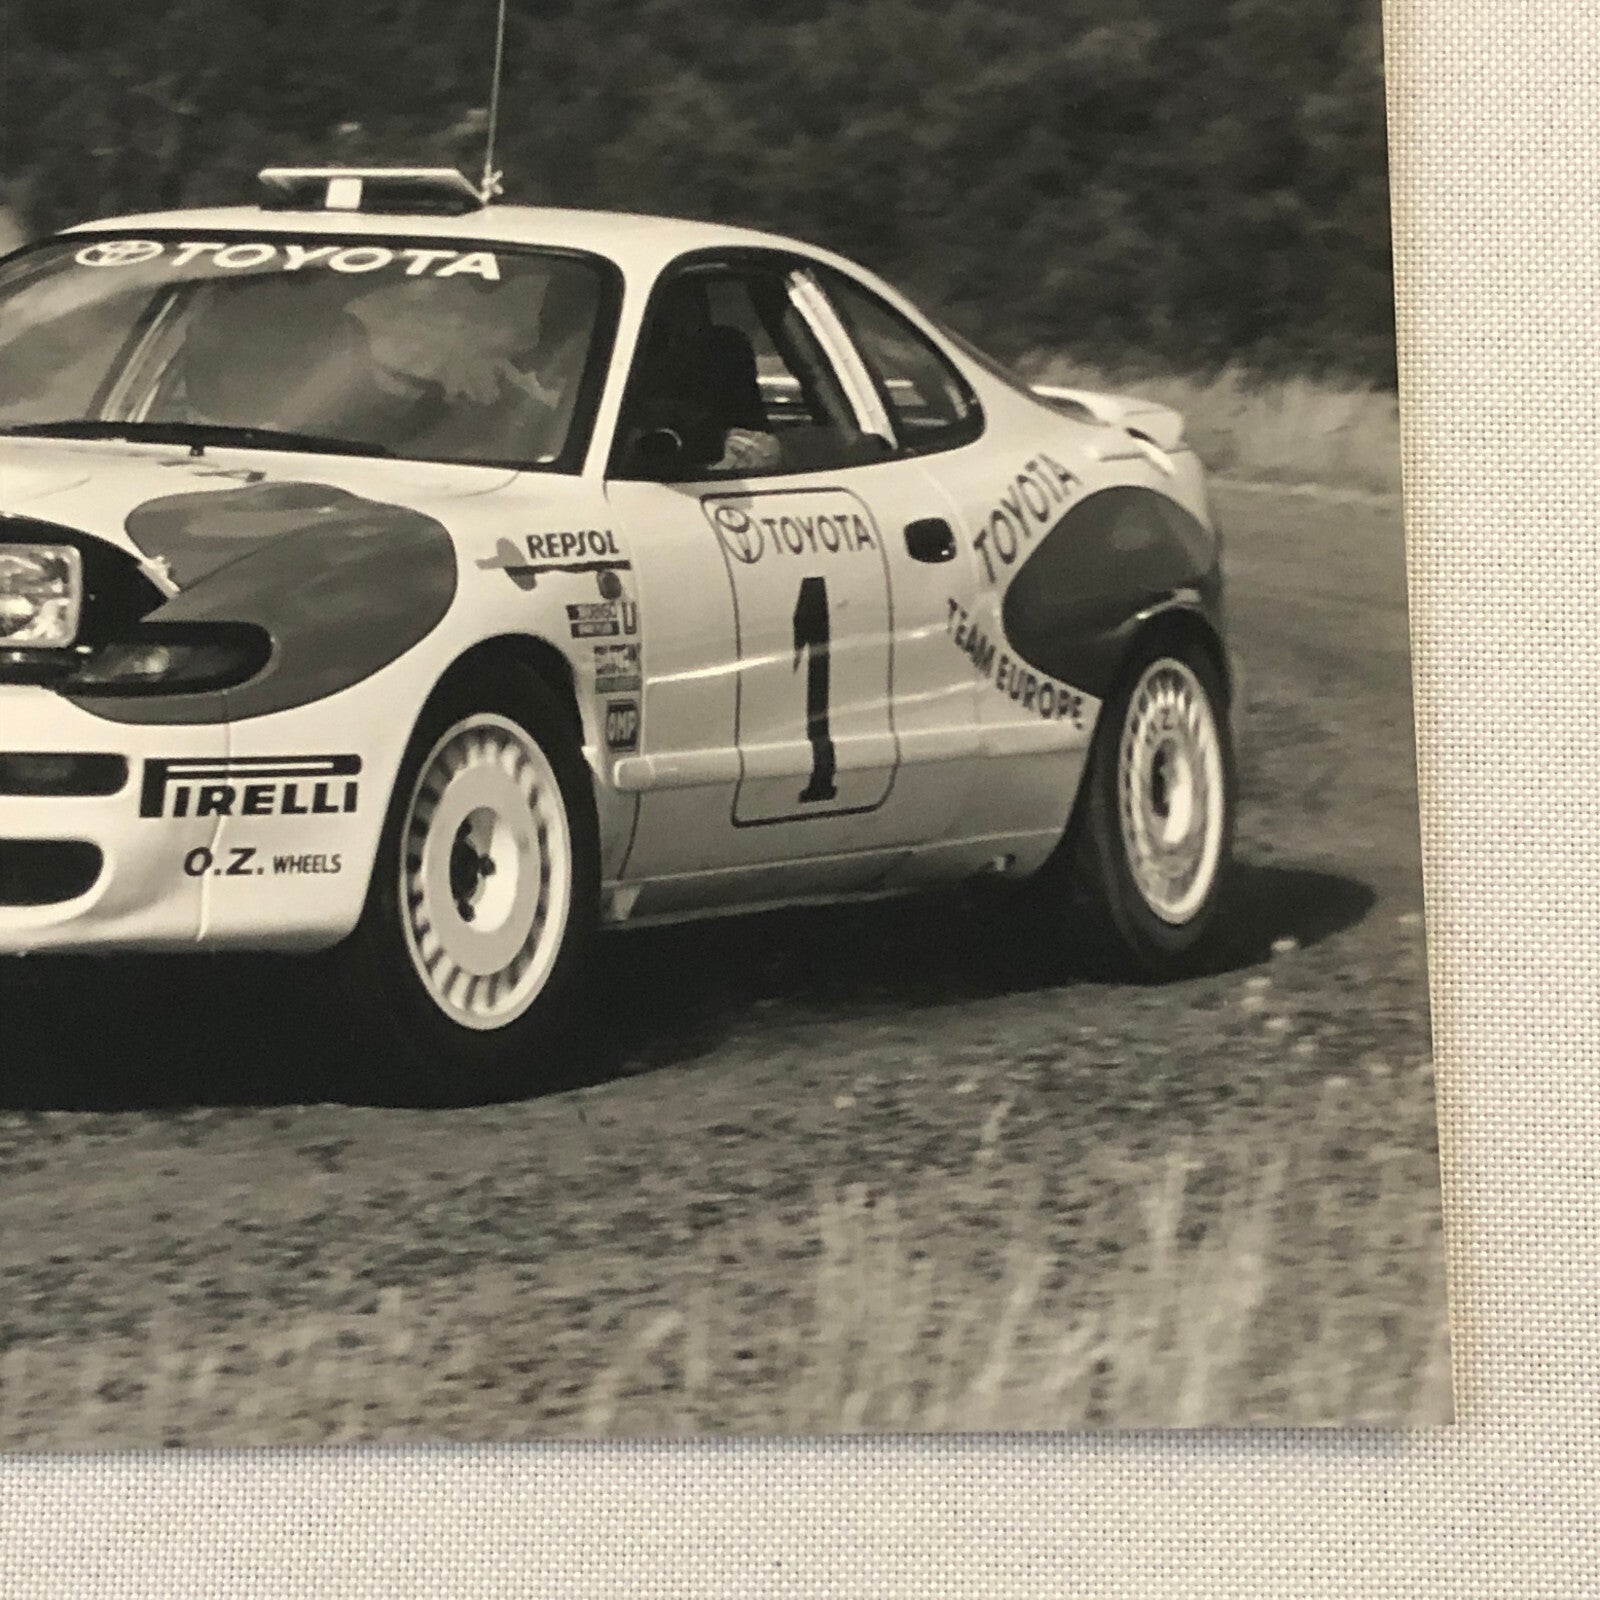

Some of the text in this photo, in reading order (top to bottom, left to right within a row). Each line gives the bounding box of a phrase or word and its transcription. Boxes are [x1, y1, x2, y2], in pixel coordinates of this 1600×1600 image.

[172, 243, 500, 280] TOYOTA
[526, 530, 619, 559] REPSOL
[761, 513, 877, 554] TOYOTA
[974, 453, 1083, 584] TOYOTA
[793, 576, 838, 803] 1
[948, 598, 996, 679] TEAM
[996, 654, 1083, 730] EUROPE
[139, 754, 362, 817] PIRELLI
[184, 847, 342, 876] O.Z. WHEELS
